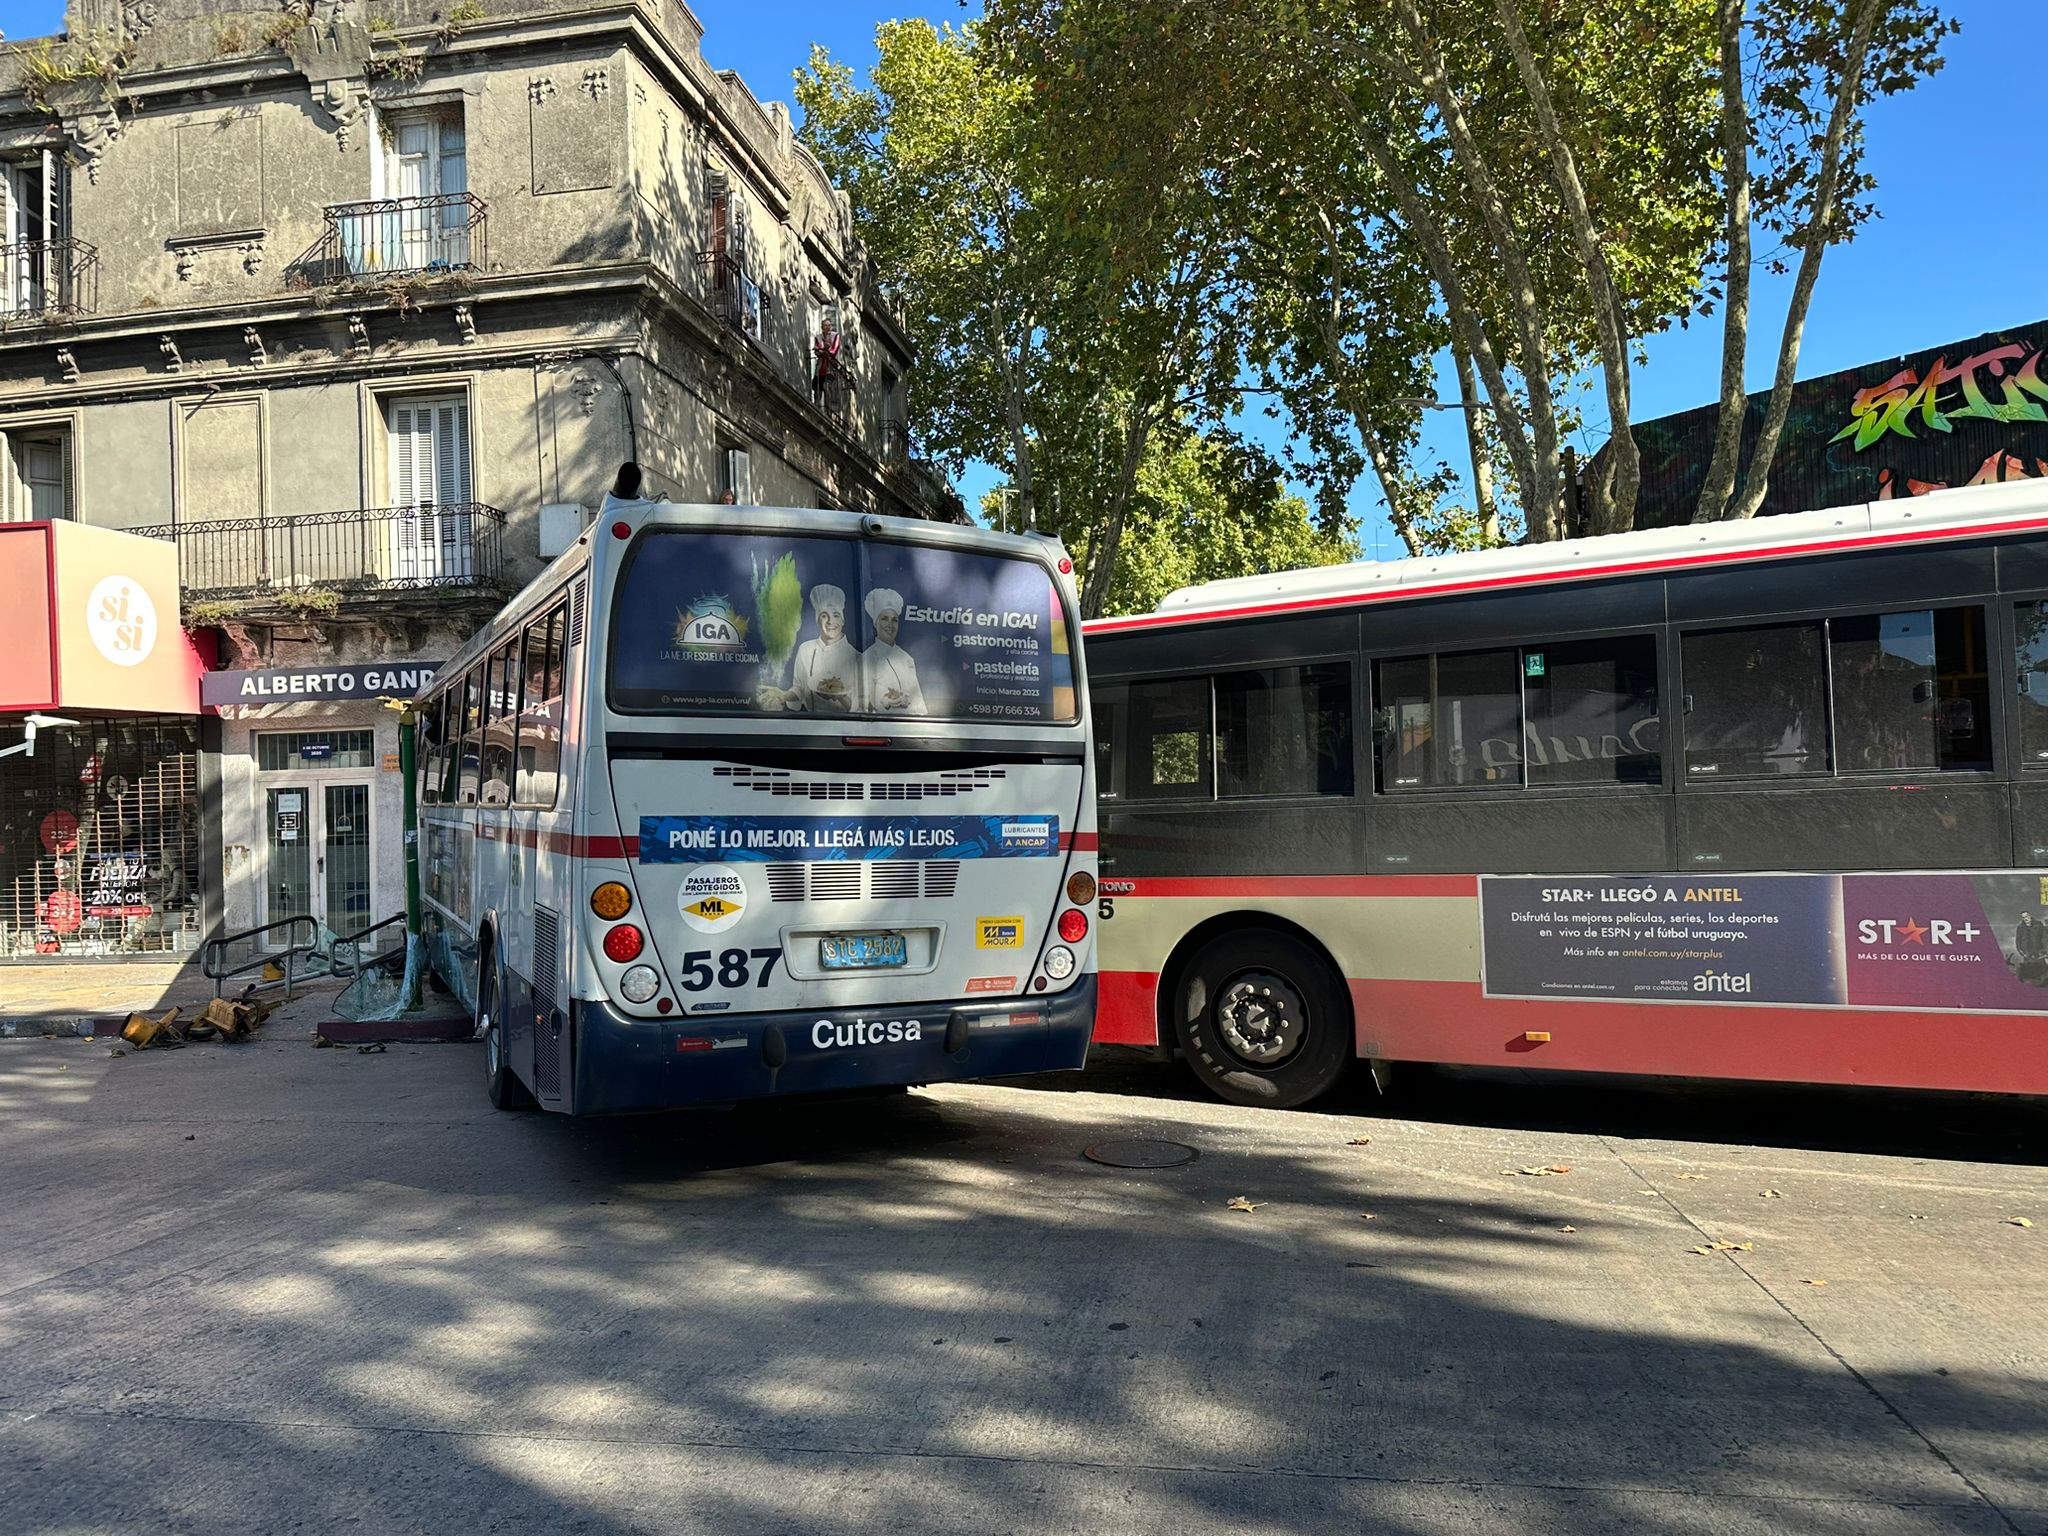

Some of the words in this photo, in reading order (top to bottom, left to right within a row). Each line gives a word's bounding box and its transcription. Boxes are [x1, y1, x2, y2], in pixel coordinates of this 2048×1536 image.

[99, 586, 130, 622] si
[904, 604, 973, 625] Estudiá
[975, 612, 999, 627] en
[1002, 611, 1038, 630] IGA!
[113, 615, 144, 651] si
[695, 622, 731, 640] IGA
[953, 634, 1039, 650] gastronomía
[660, 650, 670, 660] LA
[671, 650, 693, 661] MEJOR
[694, 651, 723, 662] ESCUELA
[725, 652, 734, 662] DE
[735, 653, 760, 663] COCINA
[974, 661, 1040, 676] pastelería
[240, 673, 355, 696] ALBERTO
[363, 669, 435, 691] GAND
[998, 687, 1021, 696] Marzo
[1022, 688, 1040, 697] 2023
[968, 704, 991, 714] +598
[992, 704, 1004, 714] 97
[1005, 705, 1023, 716] 666
[1023, 706, 1041, 717] 334
[669, 826, 716, 849] PONÉ
[720, 830, 743, 848] LO
[748, 829, 810, 848] MEJOR.
[814, 826, 864, 848] LLEGÁ
[869, 826, 905, 847] MÁS
[909, 829, 959, 846] LEJOS.
[1014, 838, 1047, 847] ANCAP
[685, 883, 741, 892] PROTEGIDOS
[688, 876, 739, 885] PASAJEROS
[1541, 888, 1594, 902] STAR+
[1600, 884, 1658, 902] LLEGÓ
[1663, 888, 1678, 902] A
[1683, 888, 1743, 902] ANTEL
[700, 901, 725, 913] ML
[1098, 898, 1114, 920] 5
[1511, 912, 1551, 922] Disfrutá
[1553, 912, 1569, 922] las
[1572, 912, 1613, 925] mejores
[1616, 912, 1666, 925] películas,
[1670, 913, 1705, 924] series,
[1708, 912, 1725, 923] los
[1728, 912, 1779, 926] deportes
[984, 938, 1016, 946] MOURA
[1540, 929, 1552, 937] en
[1559, 927, 1581, 937] vivo
[1584, 927, 1598, 938] de
[1601, 927, 1631, 938] ESPN
[1634, 930, 1642, 941] y
[1644, 927, 1654, 938] el
[1657, 927, 1688, 939] fútbol
[1692, 930, 1748, 942] uruguayo.
[827, 940, 857, 958] STC
[864, 939, 900, 957] 2587
[1563, 947, 1584, 957] Más
[1586, 946, 1604, 957] info
[1607, 949, 1619, 957] en
[1622, 947, 1723, 960] antel.com.uy/starplus
[1857, 952, 1878, 961] MÁS
[1880, 953, 1893, 961] DE
[1896, 953, 1909, 962] LO
[1911, 954, 1932, 962] QUE
[1934, 954, 1946, 962] TE
[1949, 954, 1982, 962] GUSTA
[681, 947, 783, 992] 587
[1652, 984, 1689, 992] conectarte
[1693, 969, 1751, 993] antel
[811, 1018, 922, 1049] Cutcsa
